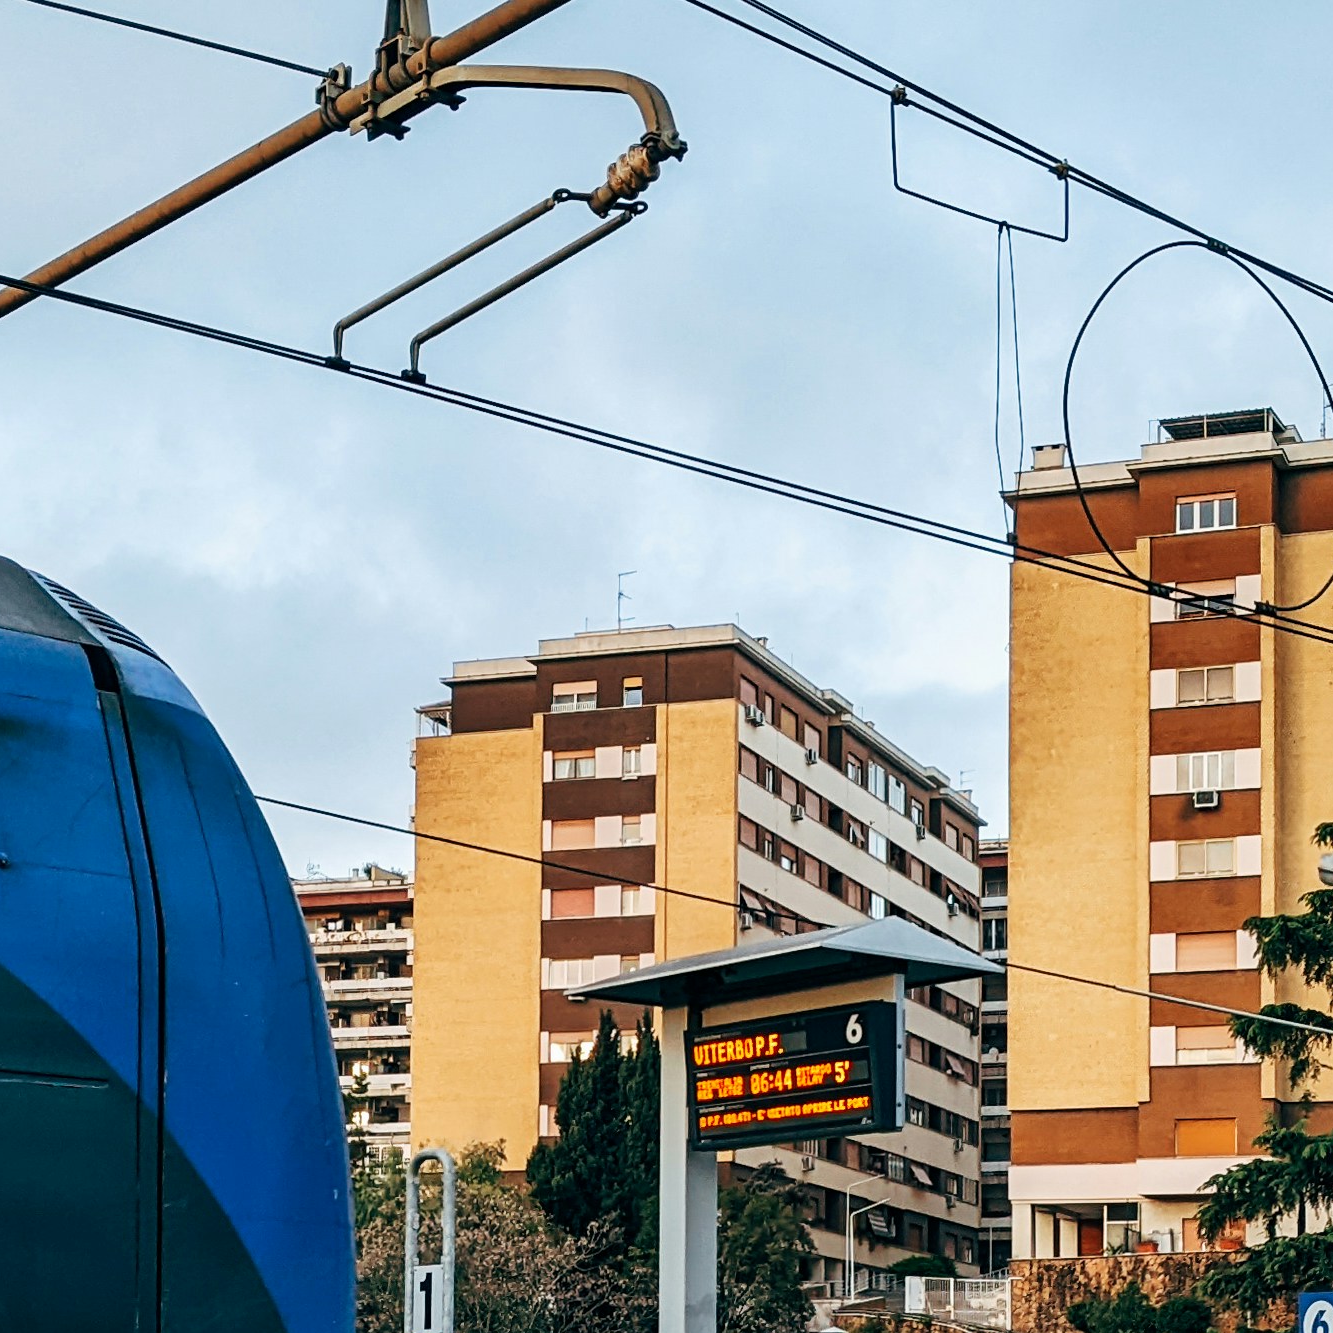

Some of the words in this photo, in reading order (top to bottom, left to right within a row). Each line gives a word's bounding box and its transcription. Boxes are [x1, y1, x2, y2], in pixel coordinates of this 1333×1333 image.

[846, 1013, 863, 1044] 6
[694, 1038, 754, 1066] VITERBO
[755, 1033, 784, 1057] P.F.
[750, 1068, 793, 1094] 06:44
[834, 1061, 850, 1083] 5'
[833, 1099, 846, 1111] LE
[419, 1272, 433, 1330] 1
